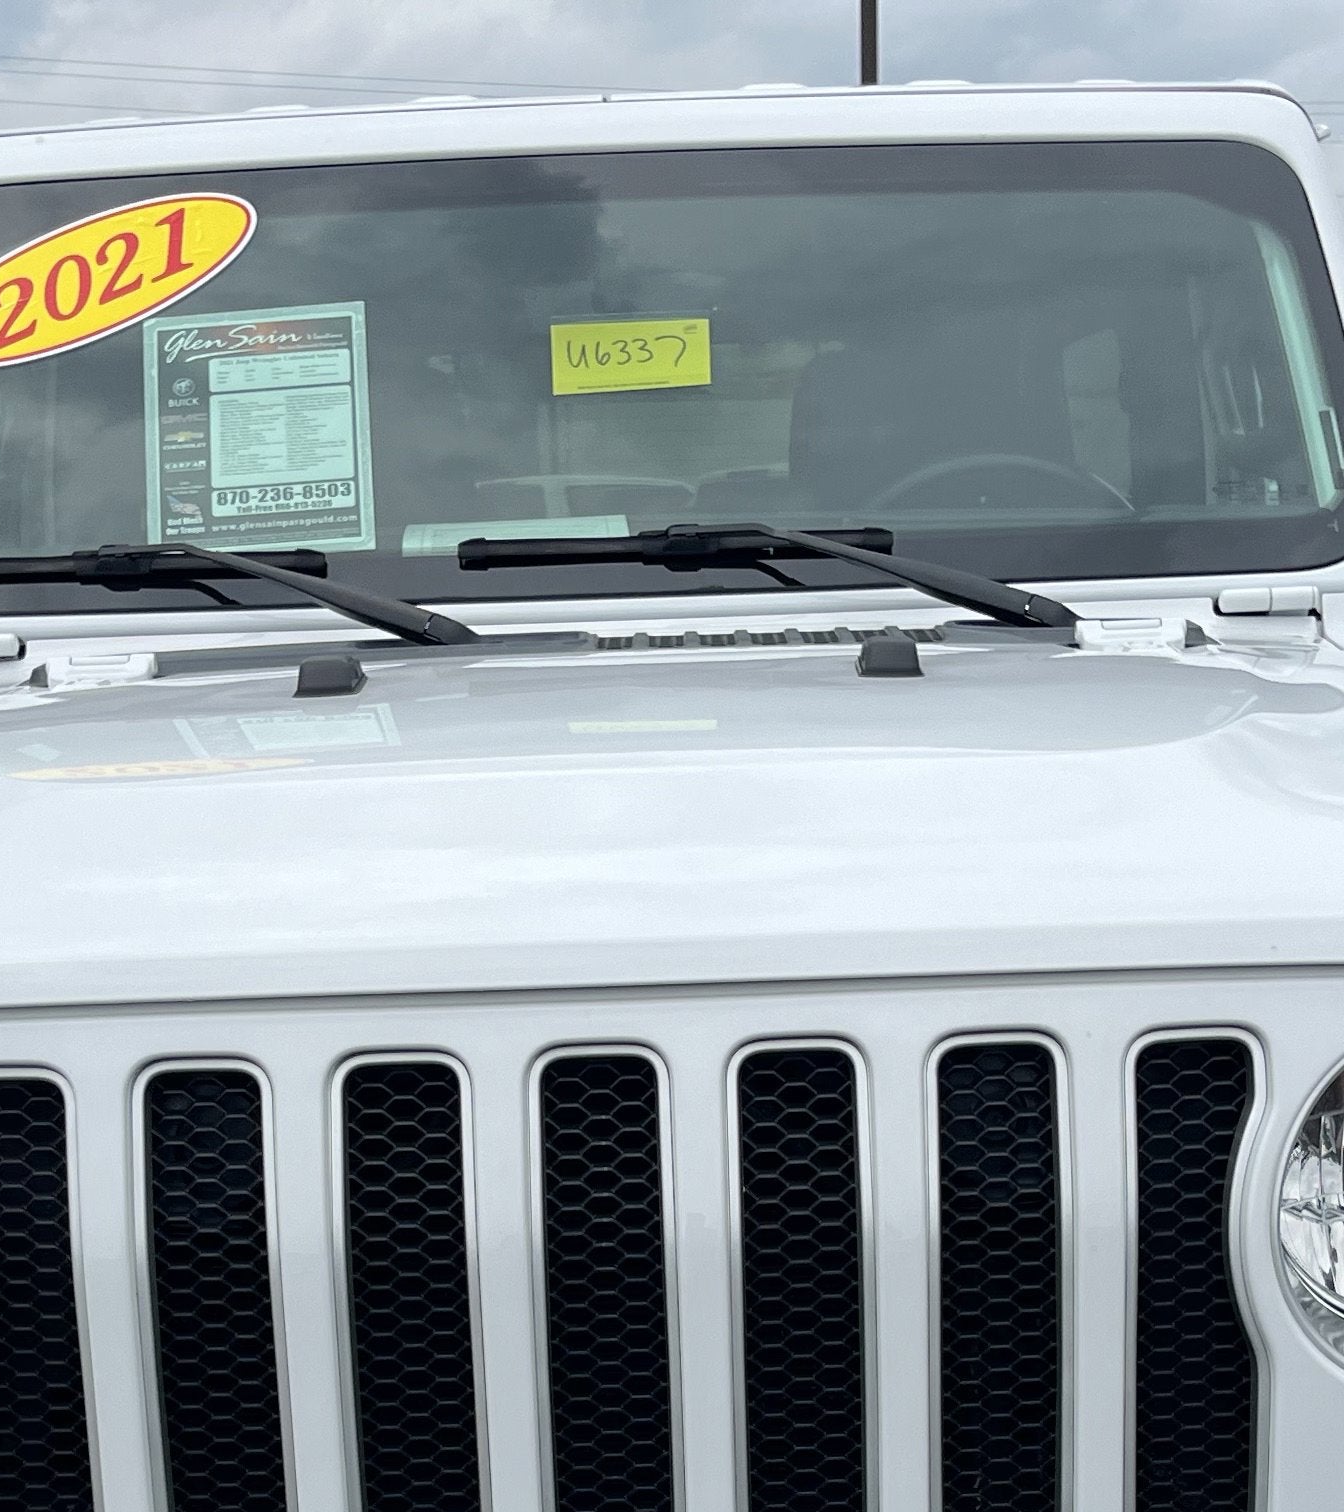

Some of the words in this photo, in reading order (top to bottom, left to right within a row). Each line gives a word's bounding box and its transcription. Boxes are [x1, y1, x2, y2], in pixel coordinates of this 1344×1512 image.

[164, 329, 227, 363] Glen
[228, 324, 303, 350] Sain
[167, 397, 200, 408] BUICK
[216, 482, 352, 506] 870-236-8503
[211, 514, 358, 532] www.glensainparagould.com
